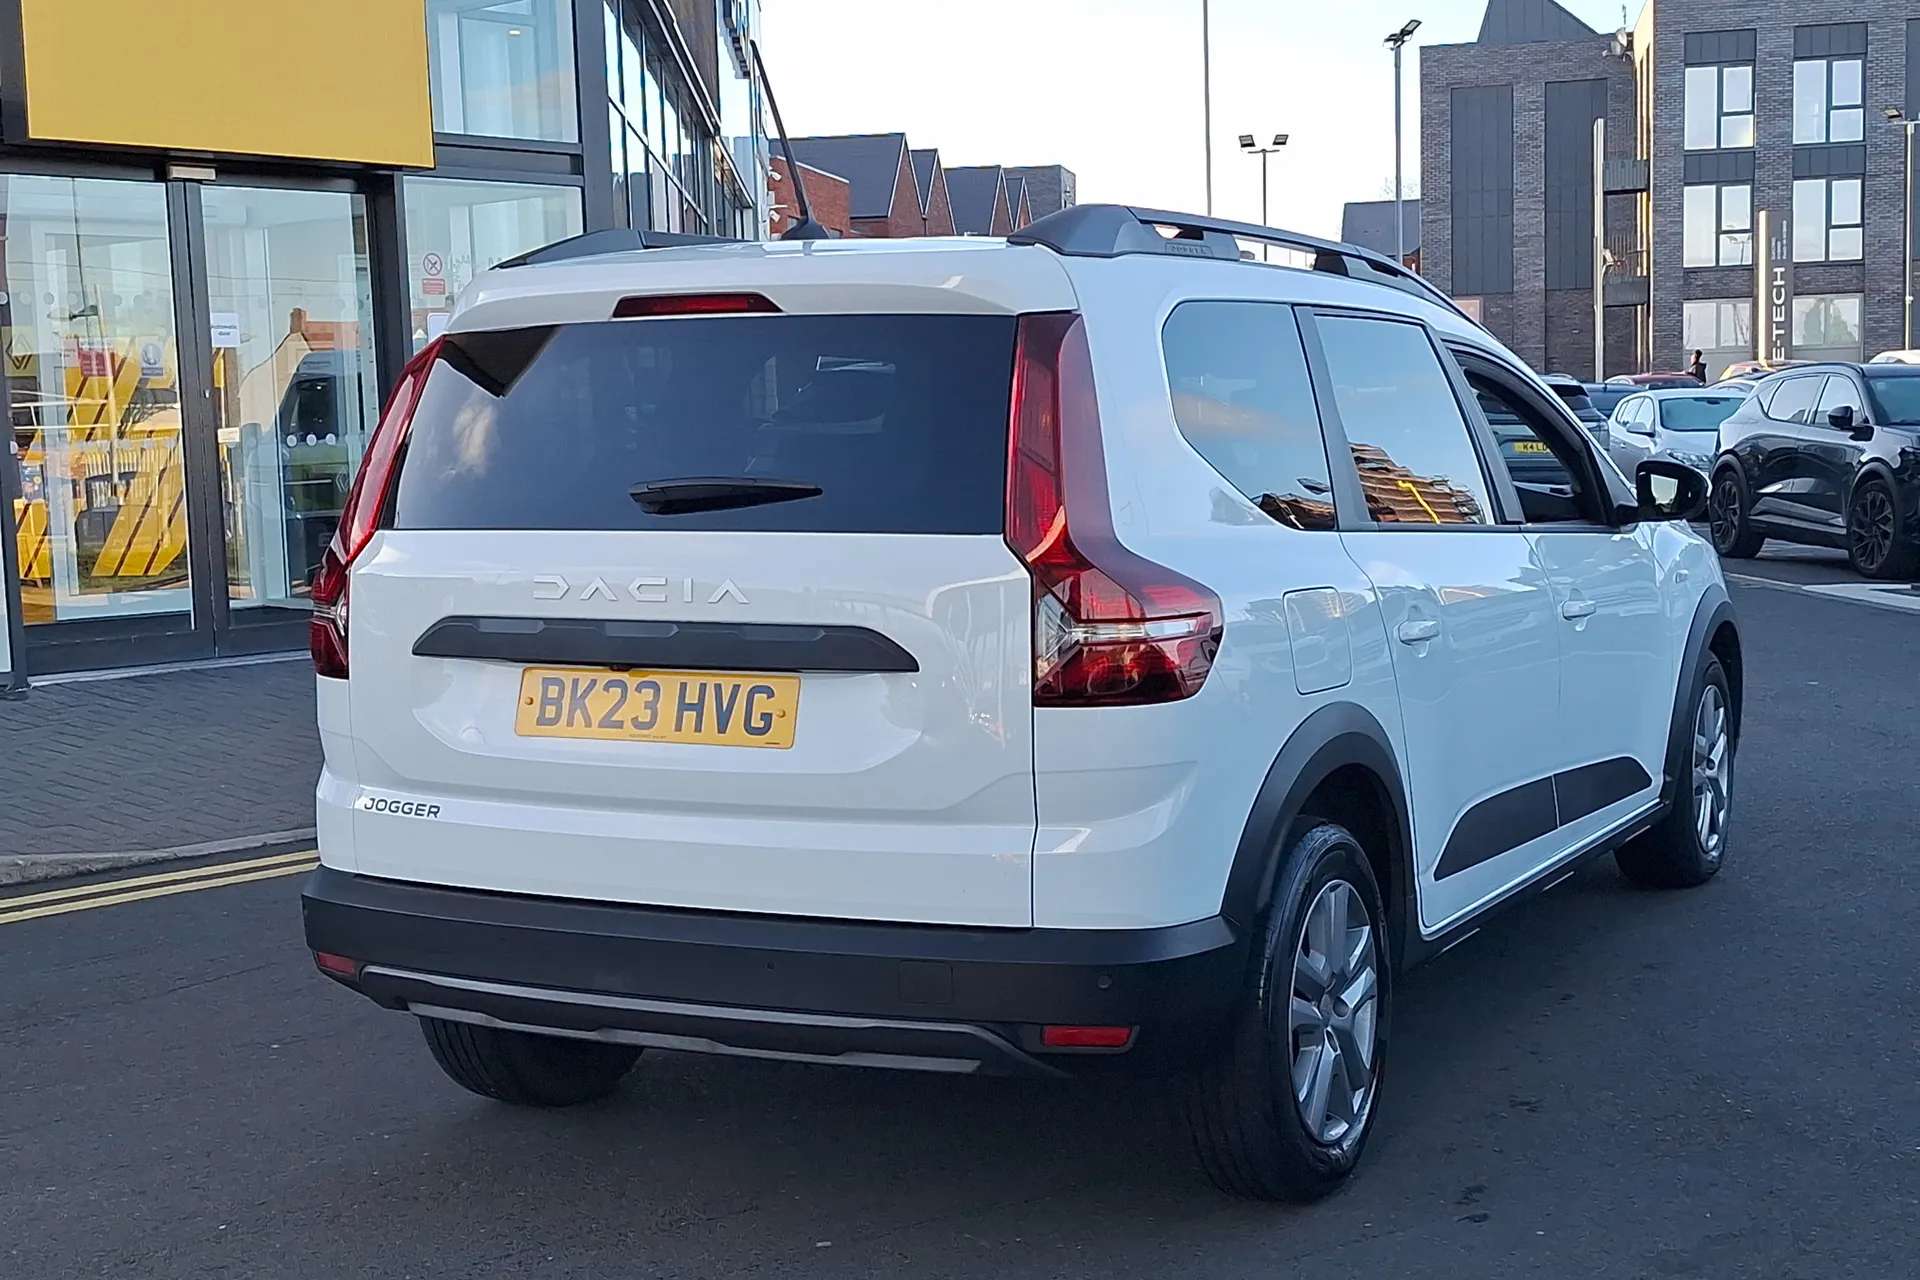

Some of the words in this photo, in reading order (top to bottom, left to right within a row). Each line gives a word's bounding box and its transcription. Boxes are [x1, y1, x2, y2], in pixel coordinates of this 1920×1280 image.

[1772, 267, 1786, 362] E-TECH
[533, 576, 750, 604] DACIA
[536, 676, 661, 731] BK23
[674, 681, 776, 737] HVG
[364, 797, 441, 818] JOGGER
